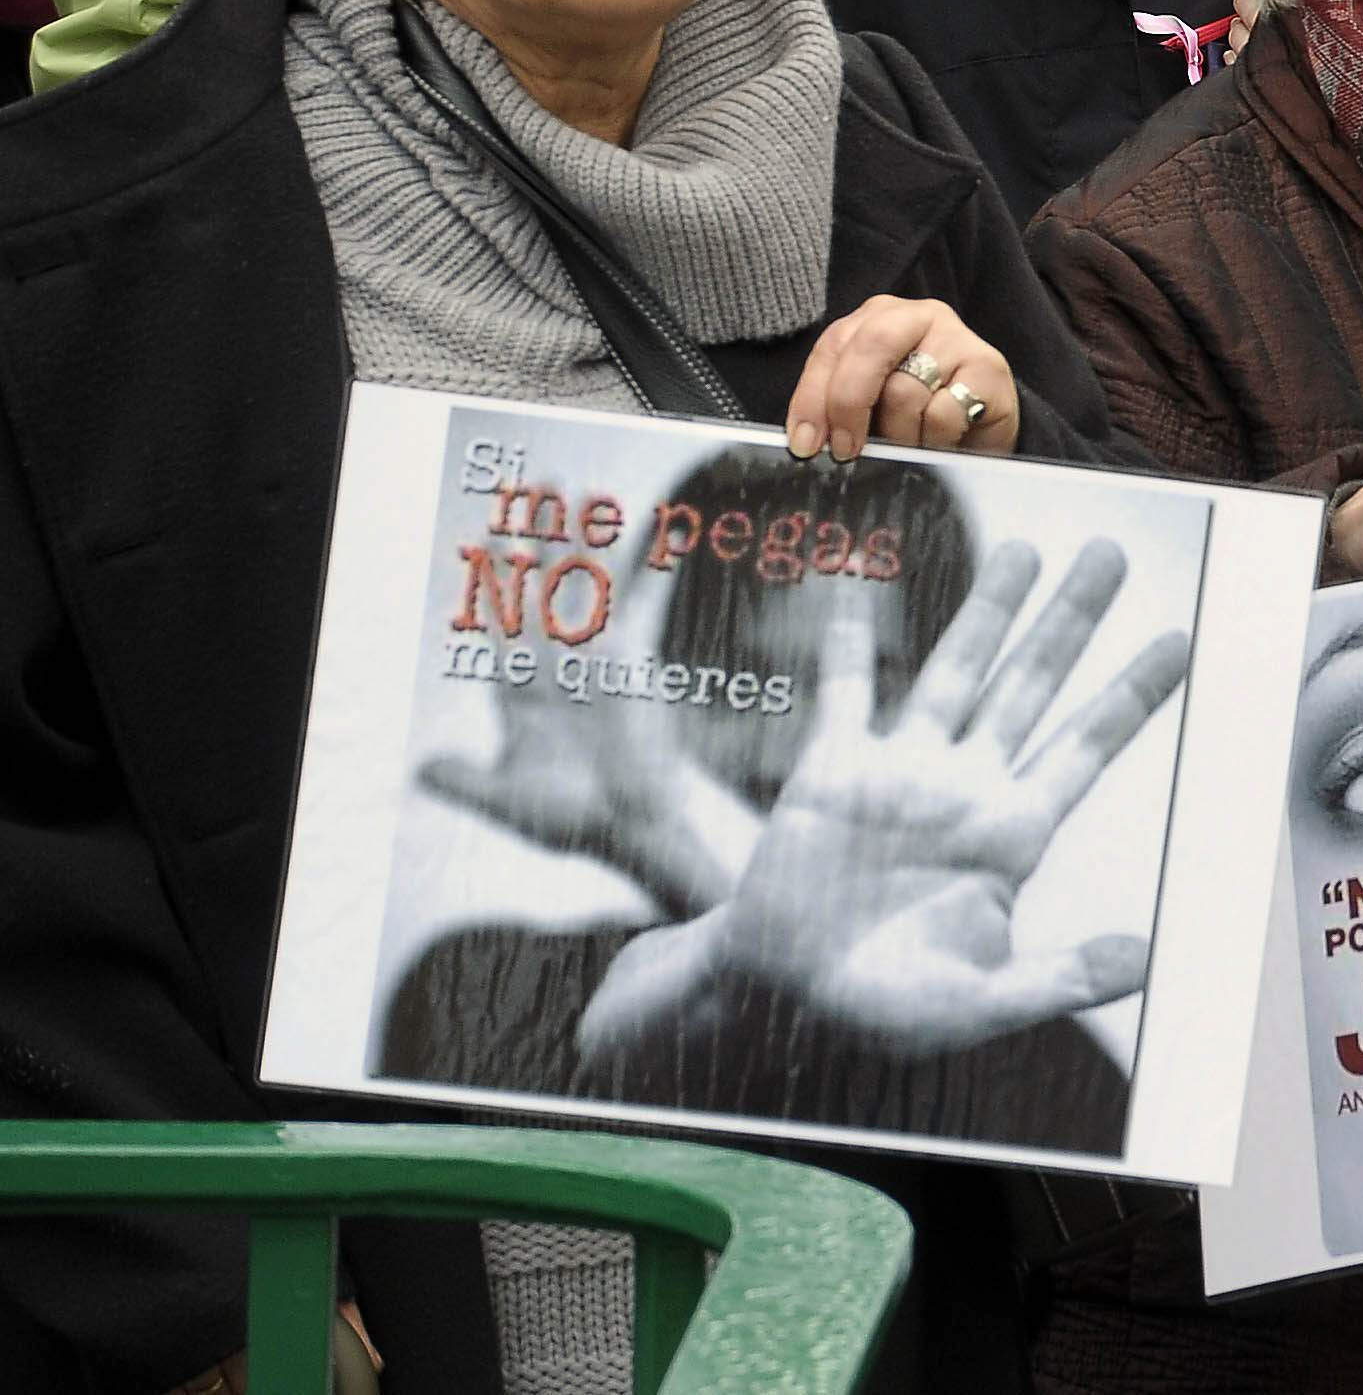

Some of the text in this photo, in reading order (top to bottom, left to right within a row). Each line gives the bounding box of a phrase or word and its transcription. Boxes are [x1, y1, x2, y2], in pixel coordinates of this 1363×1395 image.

[462, 436, 526, 495] Si
[490, 483, 903, 582] me pegas
[451, 546, 612, 645] NO
[443, 637, 792, 713] me quieres
